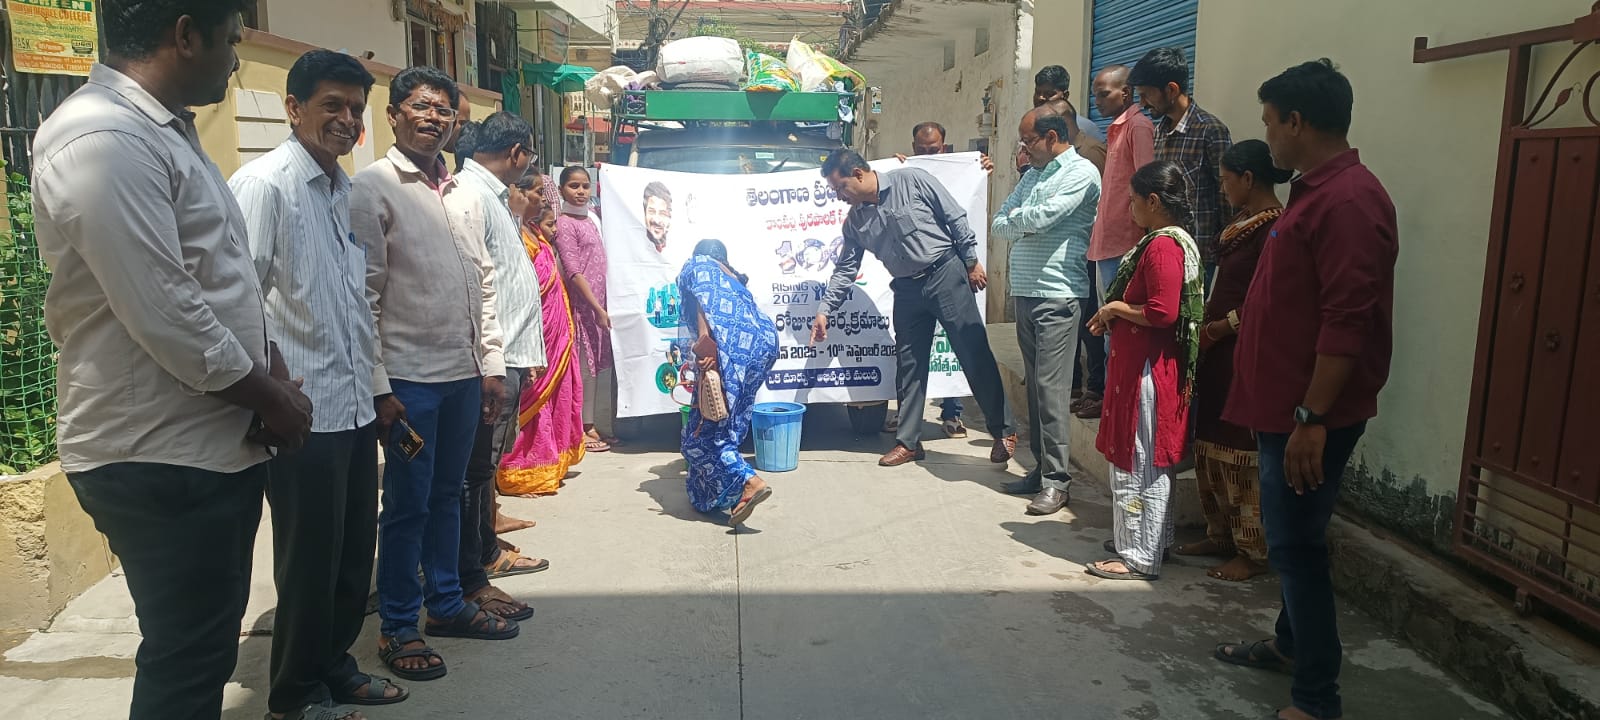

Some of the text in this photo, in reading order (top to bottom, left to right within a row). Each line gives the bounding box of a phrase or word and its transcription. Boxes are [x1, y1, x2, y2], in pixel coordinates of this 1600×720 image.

[746, 188, 810, 207] తెలంగాణ
[772, 282, 809, 293] RISING
[773, 294, 809, 304] 2047
[791, 346, 817, 358] 2025
[827, 344, 844, 357] 10th
[881, 345, 897, 357] 202
